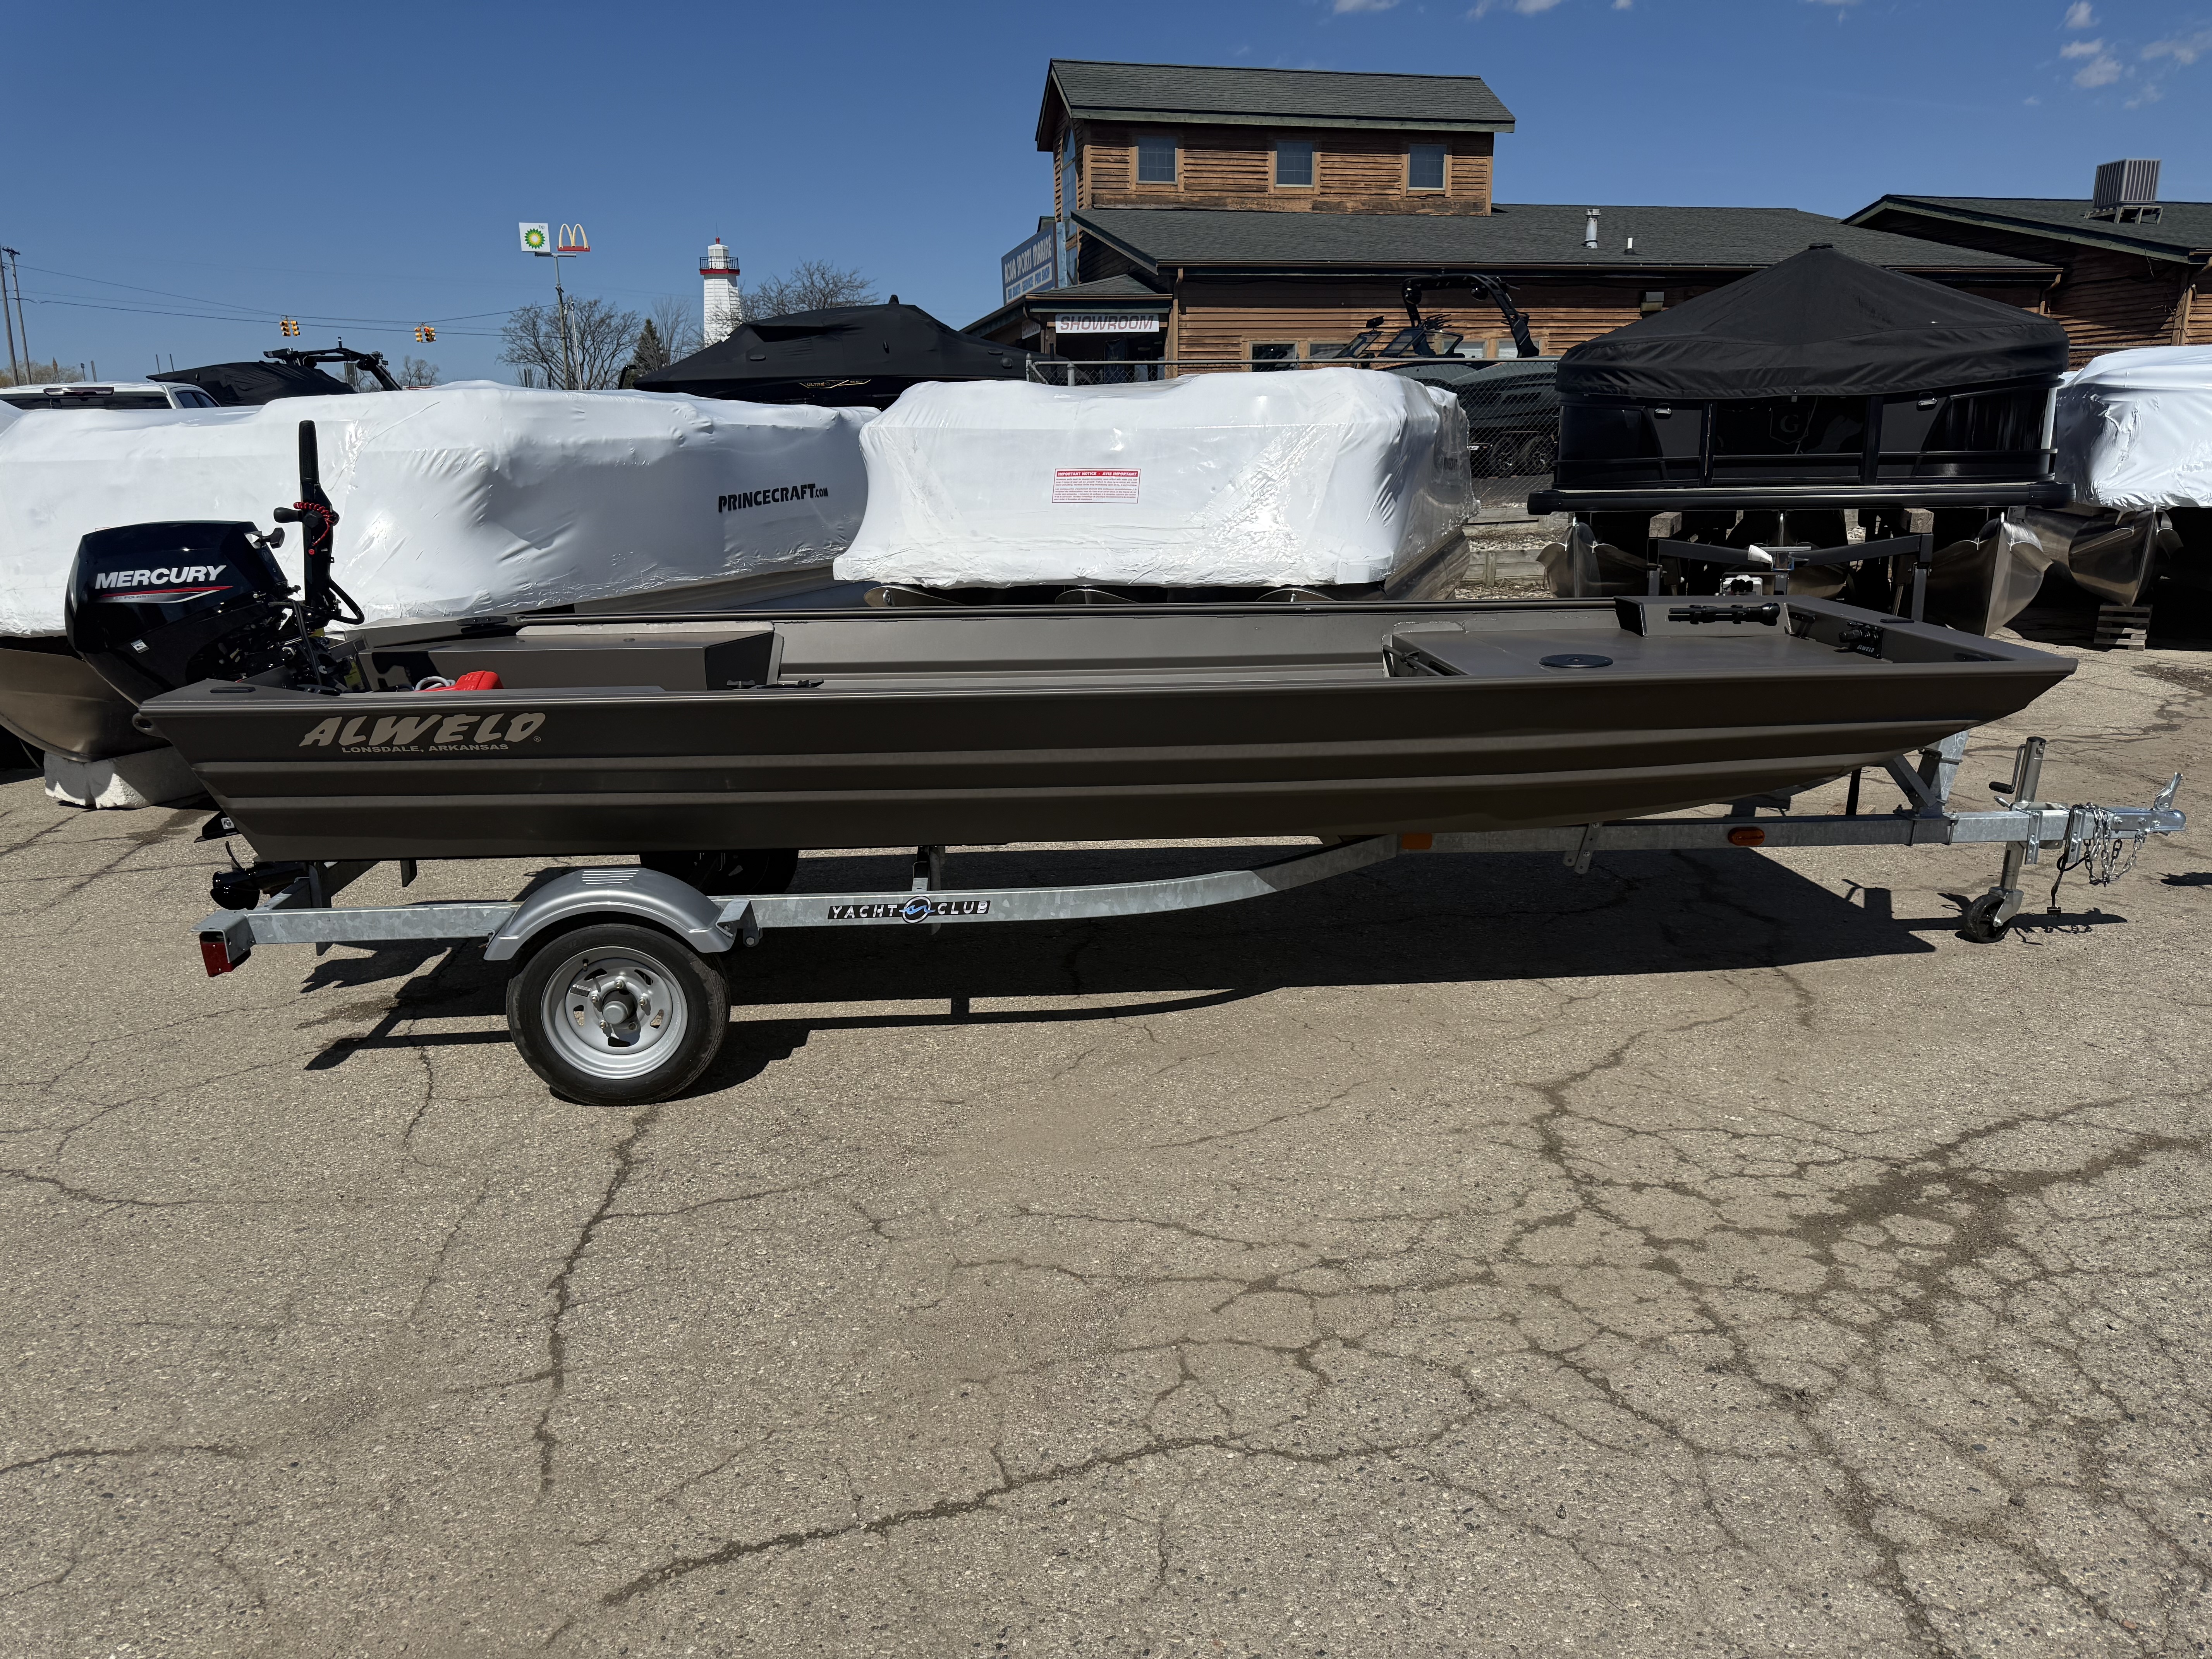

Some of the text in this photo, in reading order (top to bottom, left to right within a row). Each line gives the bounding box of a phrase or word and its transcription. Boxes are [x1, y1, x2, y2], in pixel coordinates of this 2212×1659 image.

[1005, 235, 1052, 284] AQUA SPORTS MARINE
[1060, 315, 1154, 330] SHOWROOM
[1780, 415, 1800, 433] G
[95, 565, 227, 589] MERCURY
[299, 713, 546, 747] ALWELD
[428, 743, 509, 751] ARKANSAS
[832, 901, 988, 919] YACHT CLUB
